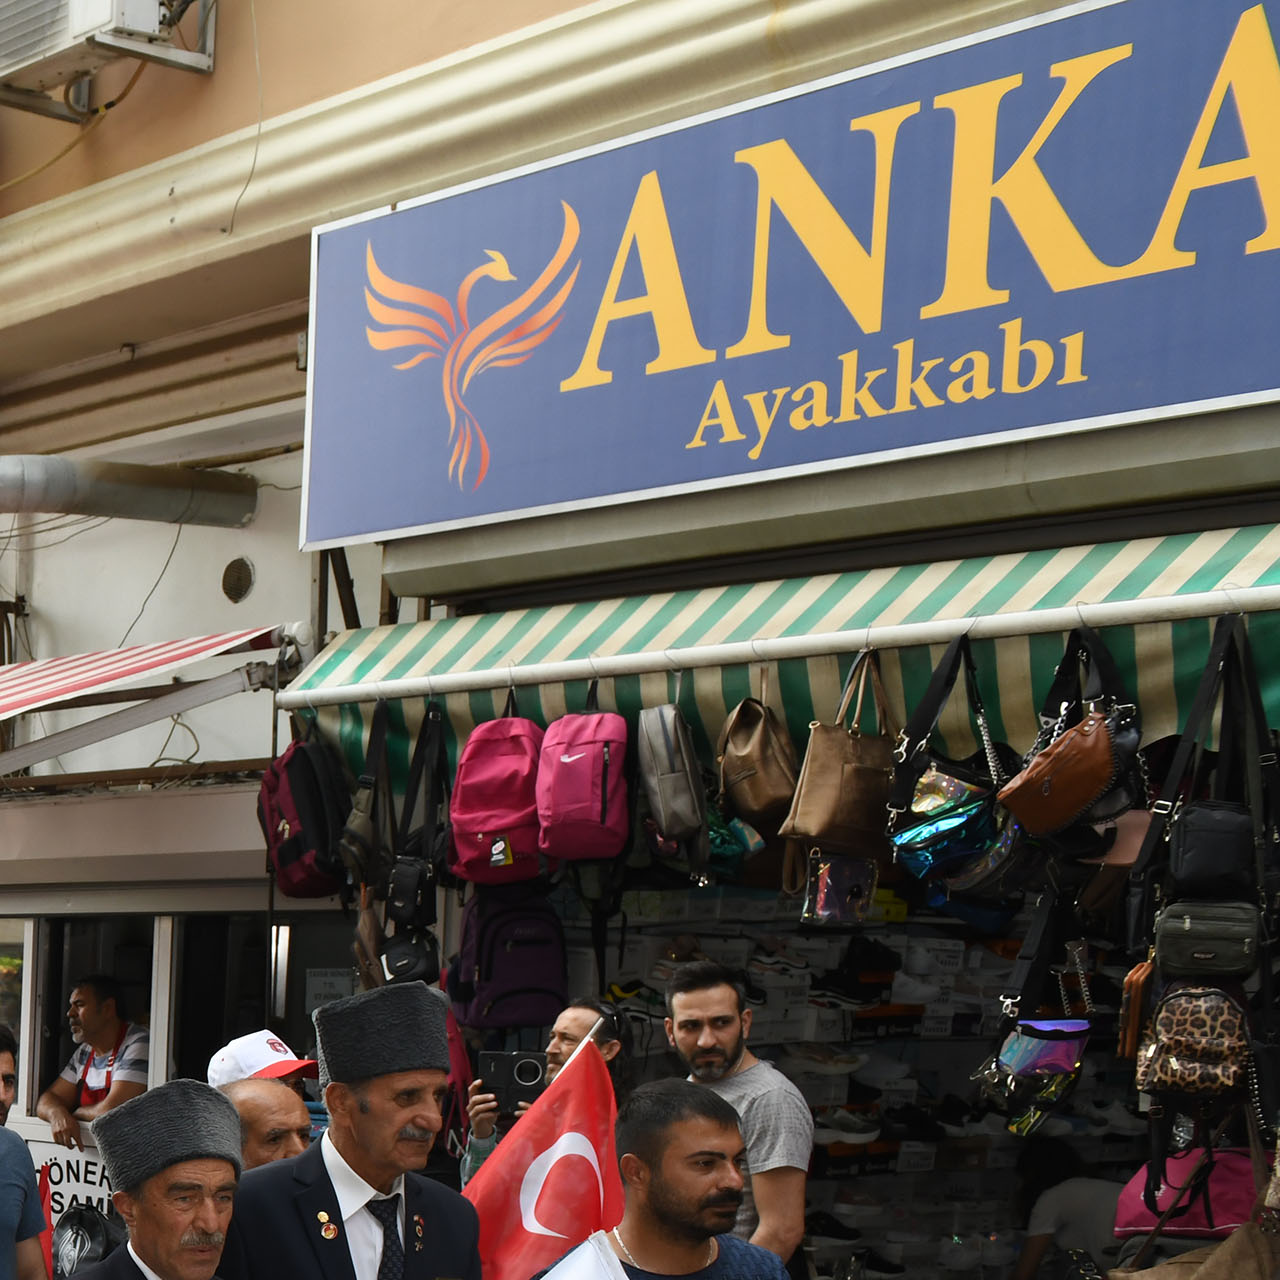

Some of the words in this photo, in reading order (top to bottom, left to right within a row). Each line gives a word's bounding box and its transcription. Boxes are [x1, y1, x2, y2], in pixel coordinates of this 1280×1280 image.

[559, 9, 1280, 393] ANKA
[684, 317, 1090, 460] Ayakkabı
[36, 1157, 113, 1189] ÖNER
